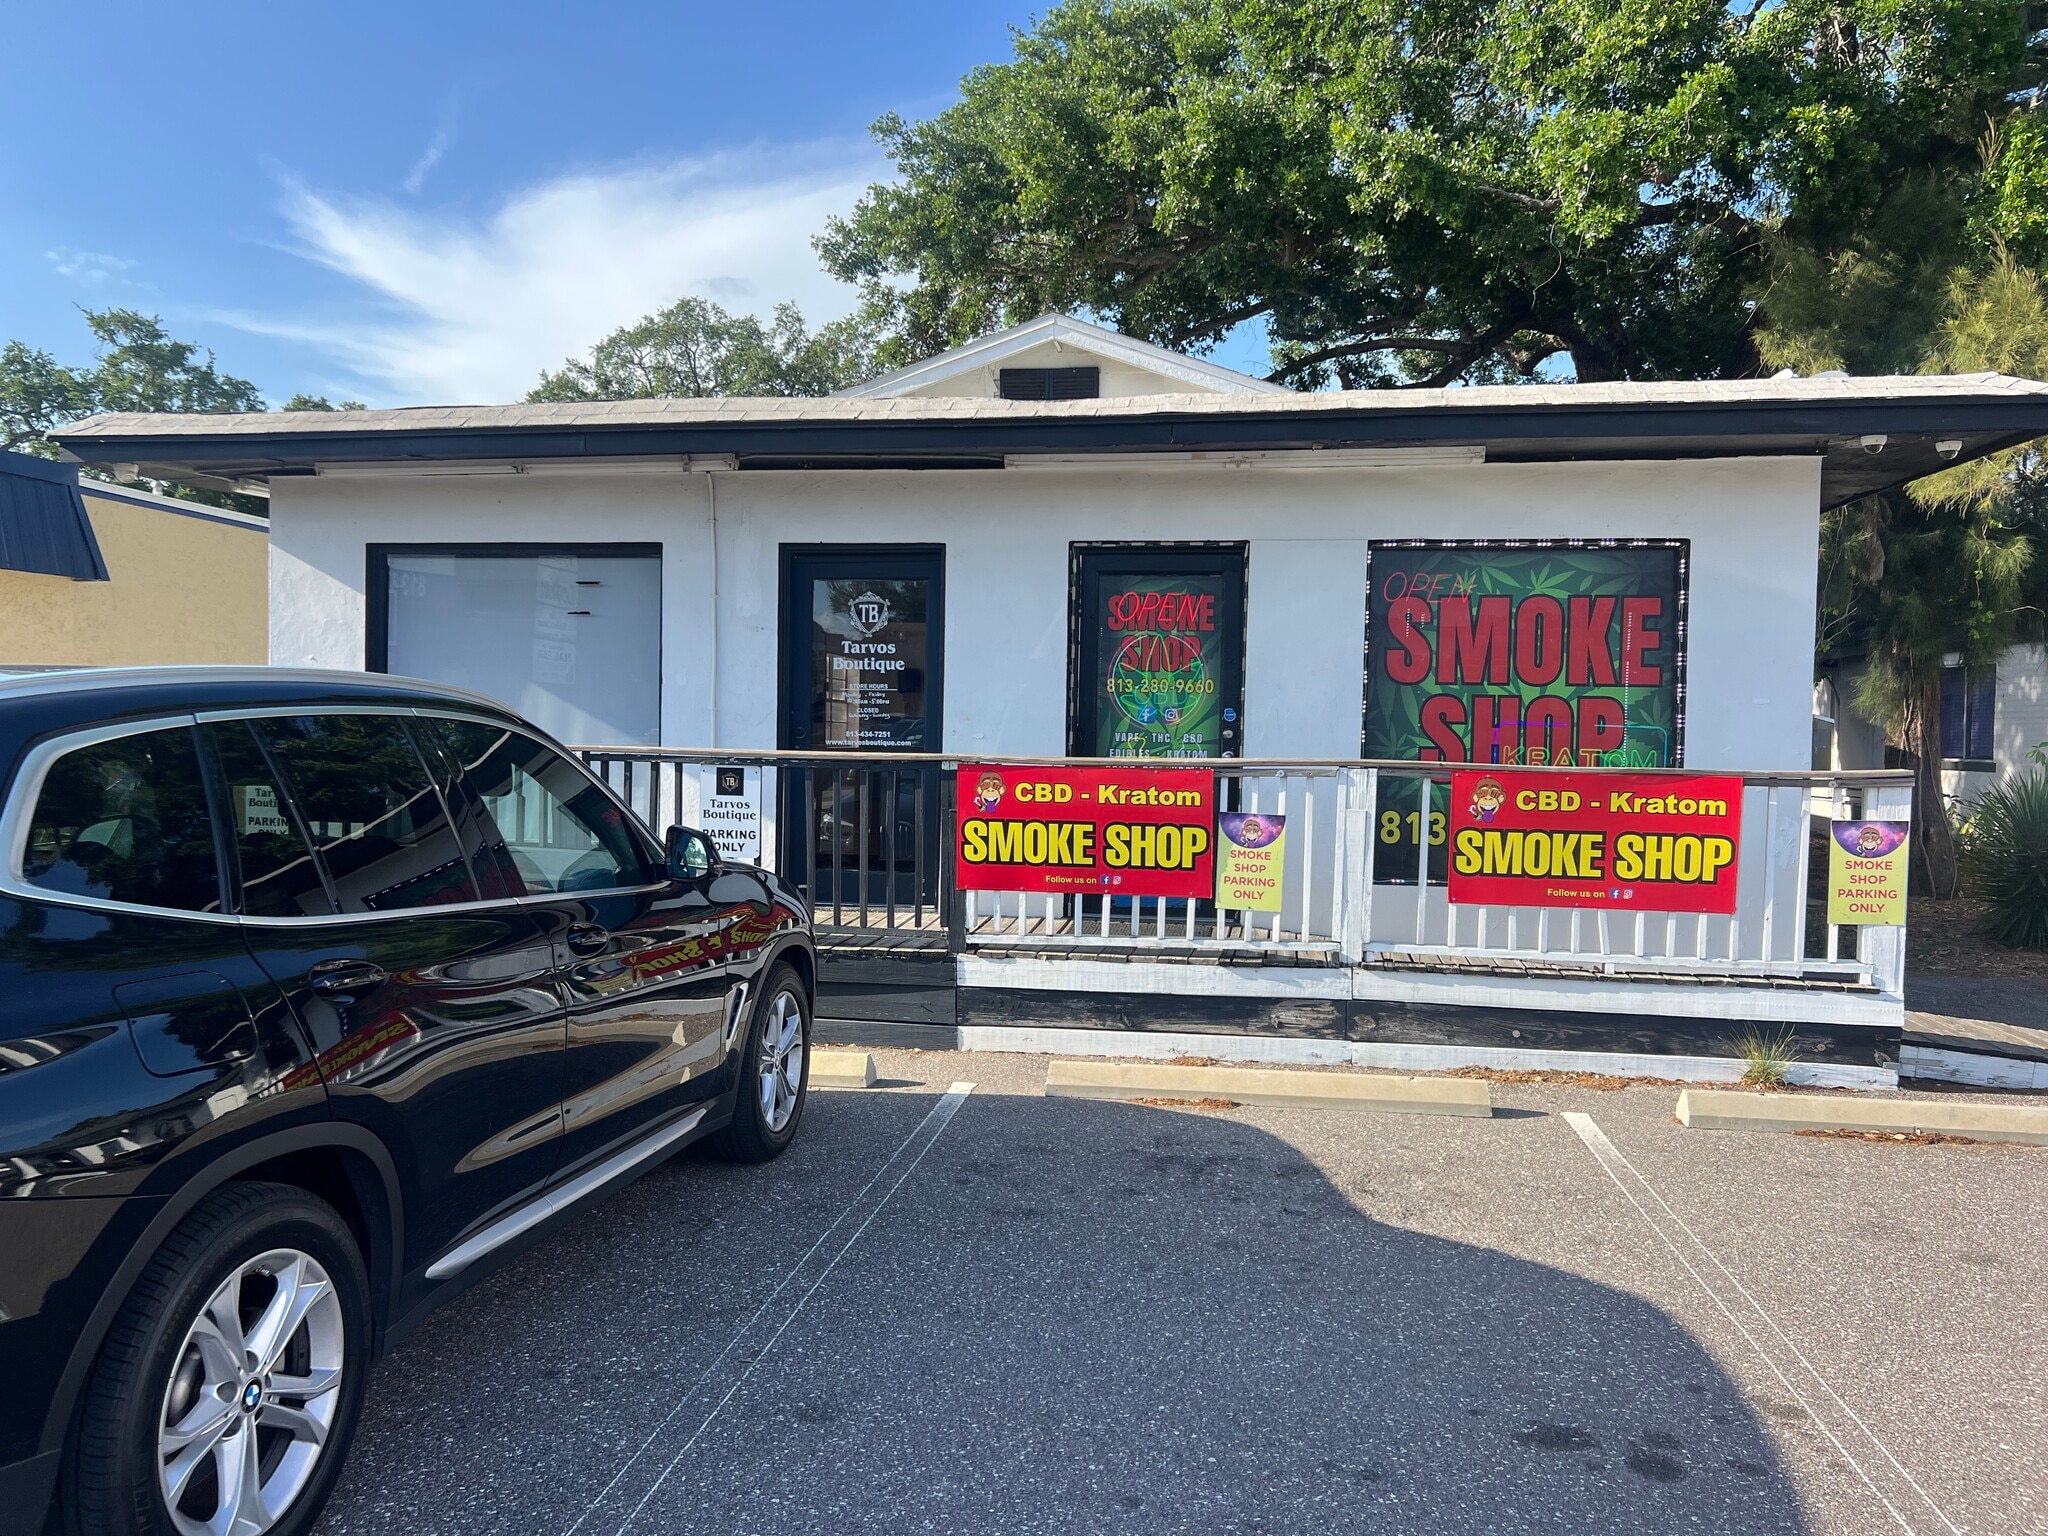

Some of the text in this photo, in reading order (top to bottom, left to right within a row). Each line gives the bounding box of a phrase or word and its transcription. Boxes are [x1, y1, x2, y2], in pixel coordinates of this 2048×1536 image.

[1383, 571, 1476, 604] OPEN
[1117, 591, 1205, 622] OPEN
[858, 604, 878, 623] TB
[1385, 594, 1662, 687] SMOKE
[841, 641, 896, 654] Tarvos
[1119, 635, 1202, 672] SHOP
[832, 658, 905, 674] Boutique
[1106, 678, 1214, 694] 813-280-9660
[1115, 732, 1203, 743] VAPE THC CBD
[1166, 750, 1208, 758] KRATOM
[1503, 745, 1657, 768] KRATOM
[255, 788, 274, 797] Tar
[1014, 782, 1073, 804] CBD
[1098, 784, 1202, 807] Kratom
[248, 798, 277, 808] Bouti
[710, 798, 750, 810] Tarvos
[1515, 790, 1581, 812] CBD
[1609, 792, 1728, 817] Kratom
[248, 816, 288, 826] PARKIN
[703, 810, 756, 822] Boutique
[963, 820, 1208, 869] SMOKE SHOP
[1230, 850, 1272, 860] SMOKE
[1455, 829, 1733, 882] SMOKE SHOP
[1234, 864, 1266, 873] SHOP
[1845, 860, 1893, 870] SMOKE
[1045, 875, 1072, 884] Follow
[1224, 876, 1275, 887] PARKING
[1850, 875, 1887, 884] SHOP
[1233, 890, 1264, 900] ONLY
[1547, 888, 1577, 897] Follow
[1838, 889, 1898, 899] PARKING
[1849, 903, 1885, 913] ONLY
